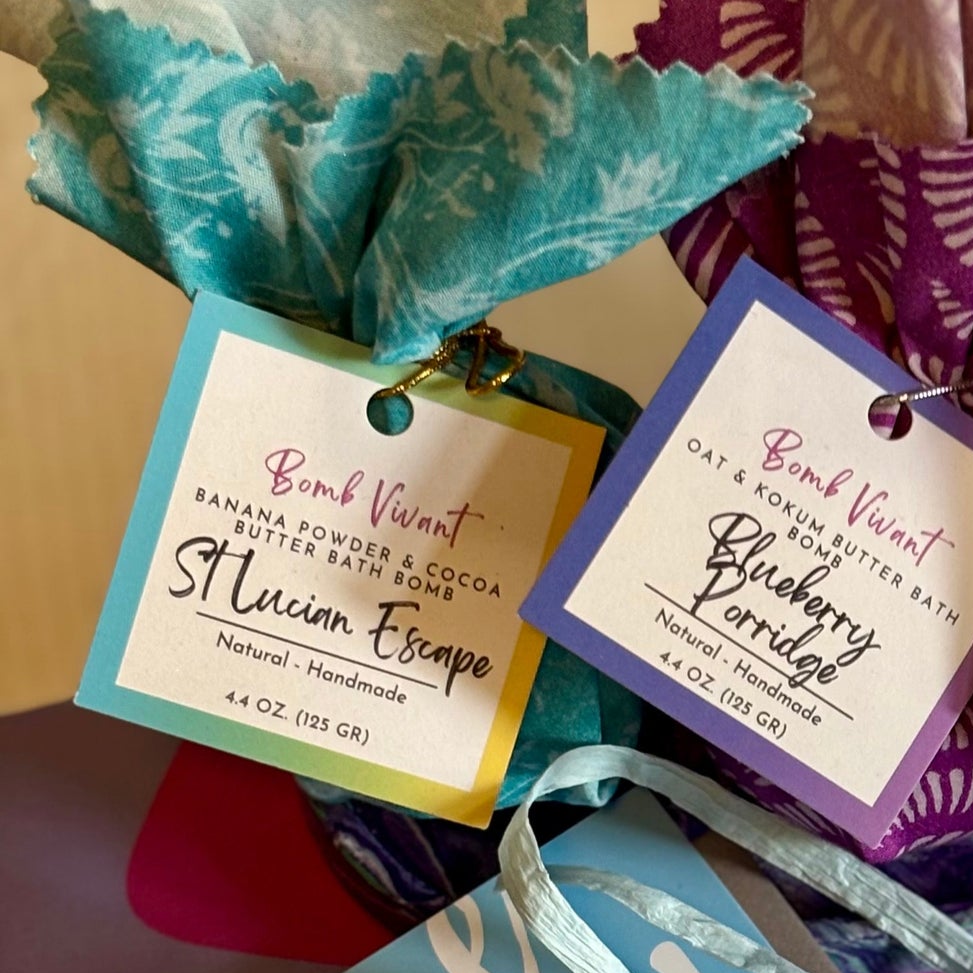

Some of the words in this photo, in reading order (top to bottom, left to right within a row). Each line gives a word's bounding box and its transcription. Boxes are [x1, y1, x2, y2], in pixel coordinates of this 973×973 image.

[194, 488, 287, 530] BANANA
[299, 521, 392, 563] POWDER
[402, 555, 415, 570] &
[426, 561, 502, 600] COCOA
[264, 448, 365, 507] Bomb
[369, 478, 485, 549] Vivant
[687, 438, 728, 471] OAT
[734, 469, 746, 485] &
[754, 483, 826, 536] KOKUM
[832, 531, 903, 589] BUTTER
[911, 587, 961, 626] BATH
[763, 428, 854, 497] Bomb
[849, 482, 956, 567] Vivant
[786, 525, 844, 570] BOMB
[234, 519, 317, 559] BUTTER
[327, 549, 383, 580] BATH
[394, 570, 455, 602] BOMB
[708, 511, 882, 667] Blueberry
[216, 630, 290, 669] Natural
[308, 659, 408, 705] Handmade
[368, 600, 494, 697] Escape
[654, 608, 722, 661] Natural
[734, 656, 823, 727] Handmade
[693, 562, 838, 689] Porridge
[225, 690, 249, 707] 4.4
[256, 698, 289, 721] OZ.
[296, 709, 331, 734] (125
[336, 721, 370, 746] GR)
[659, 650, 683, 672] 4.4
[687, 666, 715, 694] OZ.
[719, 687, 754, 718] (125
[755, 708, 788, 740] GR)
